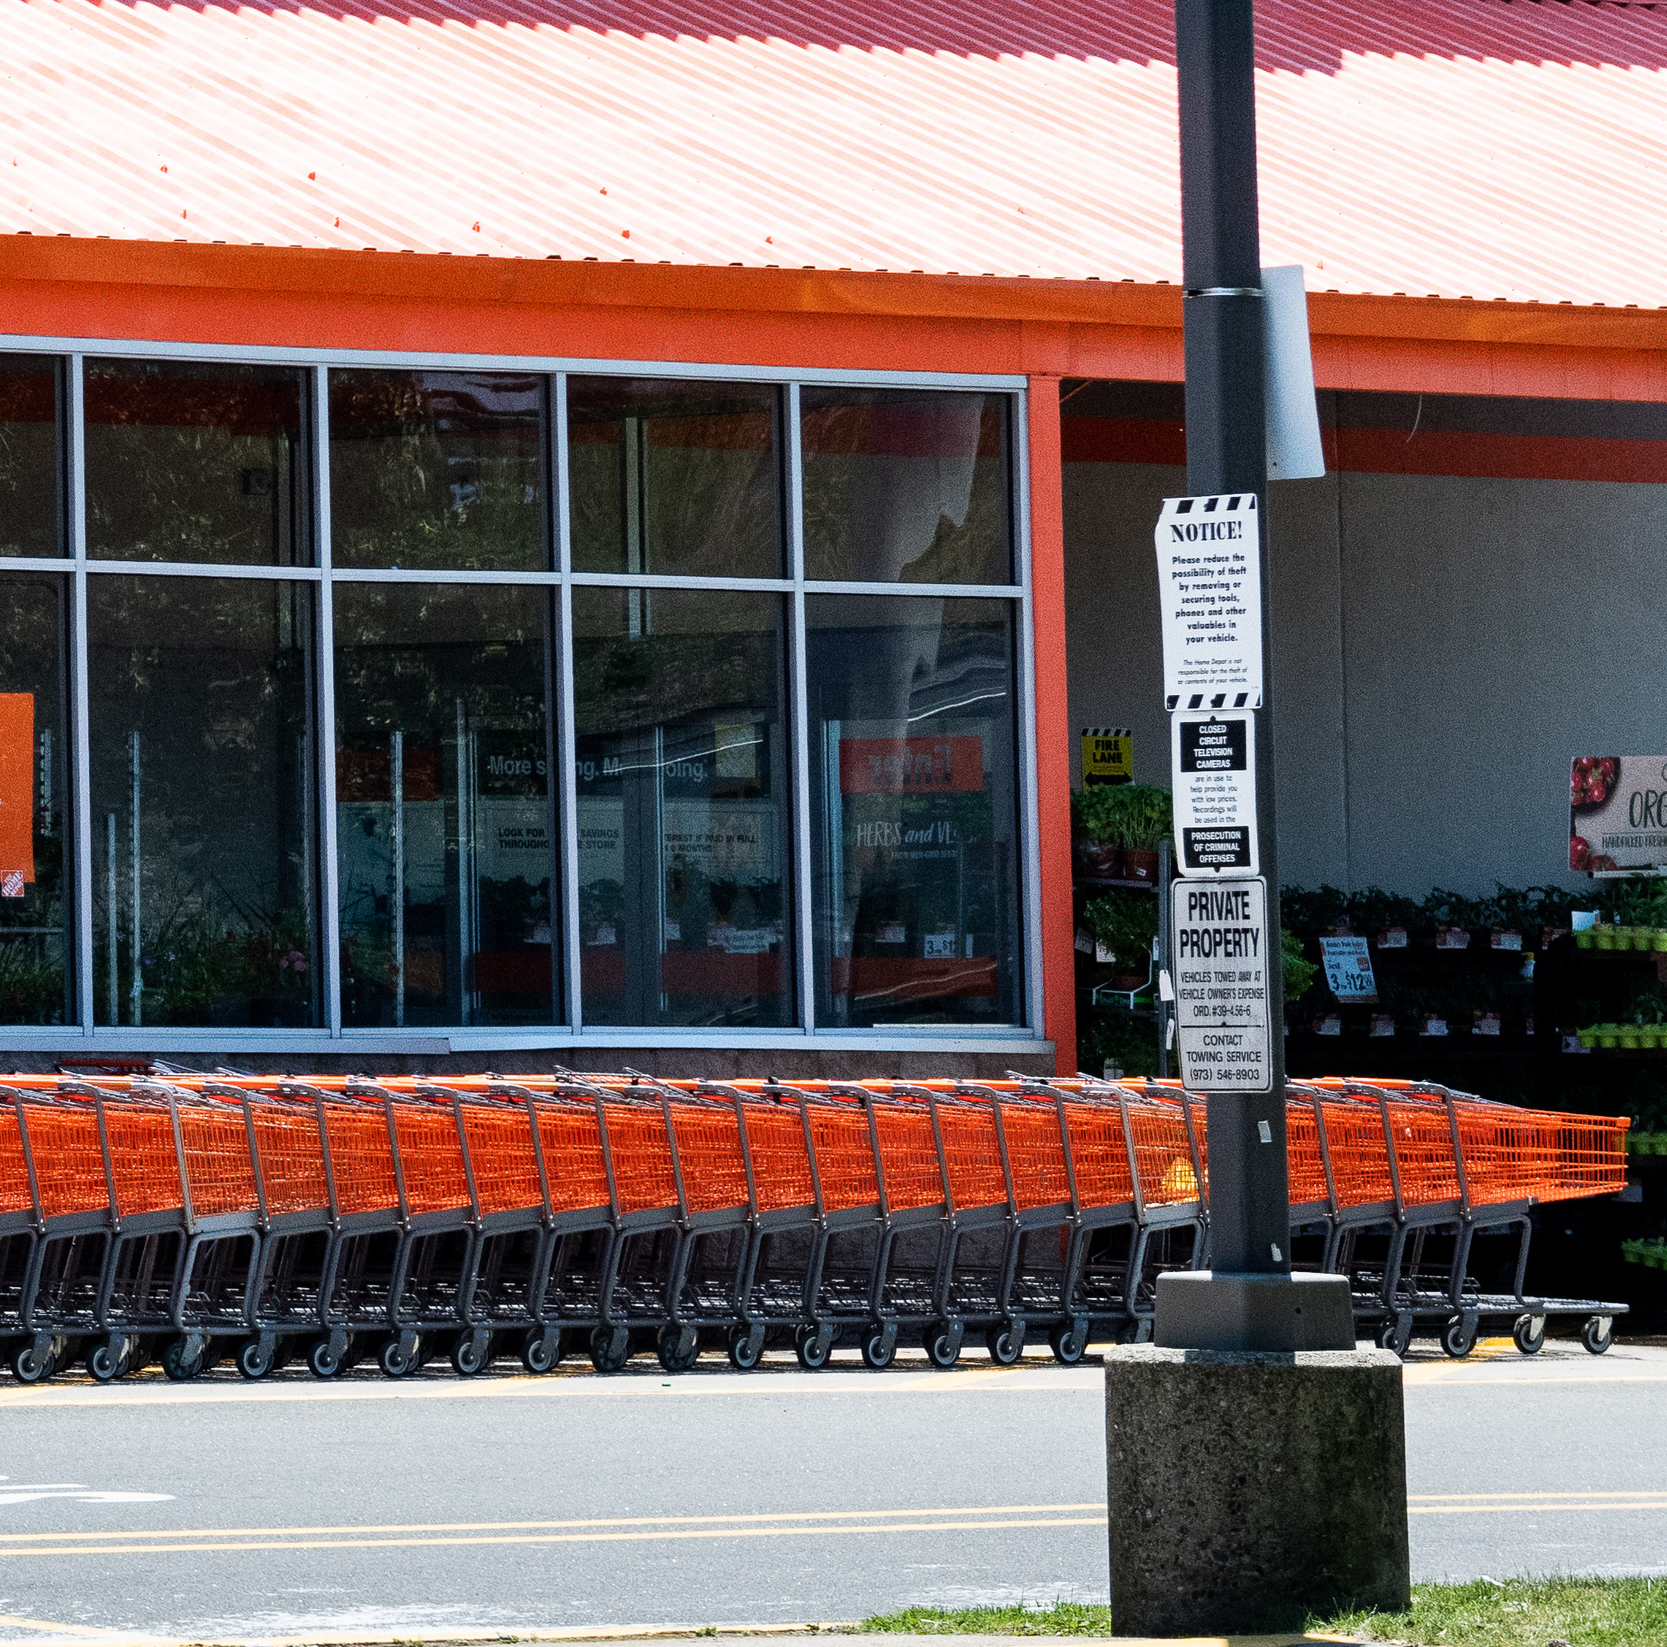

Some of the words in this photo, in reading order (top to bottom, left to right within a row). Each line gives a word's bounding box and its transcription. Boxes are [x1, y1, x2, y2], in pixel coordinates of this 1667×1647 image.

[1170, 521, 1242, 542] NOTICE!
[1172, 556, 1200, 564] Please
[1203, 554, 1229, 563] reduce
[1233, 553, 1245, 561] the
[1172, 568, 1214, 579] possibility
[1218, 567, 1225, 575] of
[1228, 566, 1246, 575] theft
[1179, 582, 1189, 592] by
[1193, 581, 1229, 591] removing
[1182, 595, 1215, 605] securing
[1218, 594, 1239, 602] tools,
[1175, 609, 1204, 619] phones
[1208, 607, 1222, 615] and
[1226, 606, 1246, 615] other
[1187, 621, 1226, 629] valuables
[1229, 620, 1236, 628] in
[1186, 637, 1204, 645] your
[1207, 633, 1238, 642] vehicle.
[1199, 725, 1227, 733] CLOSED
[1095, 740, 1119, 750] FIRE
[1199, 736, 1227, 745] CIRCUIT
[1093, 752, 1122, 763] LANE
[1193, 748, 1233, 757] TELEVISION
[1196, 760, 1230, 768] CAMERAS
[1205, 785, 1225, 793] provide
[1218, 795, 1237, 803] prices.
[1193, 806, 1225, 814] Recordings
[905, 824, 934, 843] and
[1191, 832, 1241, 840] PROSECUTION
[1194, 843, 1203, 851] OF
[1205, 843, 1240, 851] CRIMINAL
[1189, 891, 1250, 921] PRIVATE
[1180, 928, 1259, 958] PROPERTY
[1181, 972, 1211, 983] VEHICLES
[1214, 972, 1236, 982] TOWED
[1238, 972, 1252, 982] AWAY
[1254, 971, 1261, 982] AT
[1179, 989, 1205, 999] VEHICLE
[1208, 988, 1236, 999] OWNER'S
[1238, 988, 1264, 999] EXPENSE
[1204, 1035, 1243, 1045] CONTACT
[1186, 1052, 1222, 1062] TOWING
[1227, 1052, 1262, 1062] SERVICE
[1191, 1069, 1212, 1080] (973)
[1217, 1069, 1259, 1080] 546-8903
